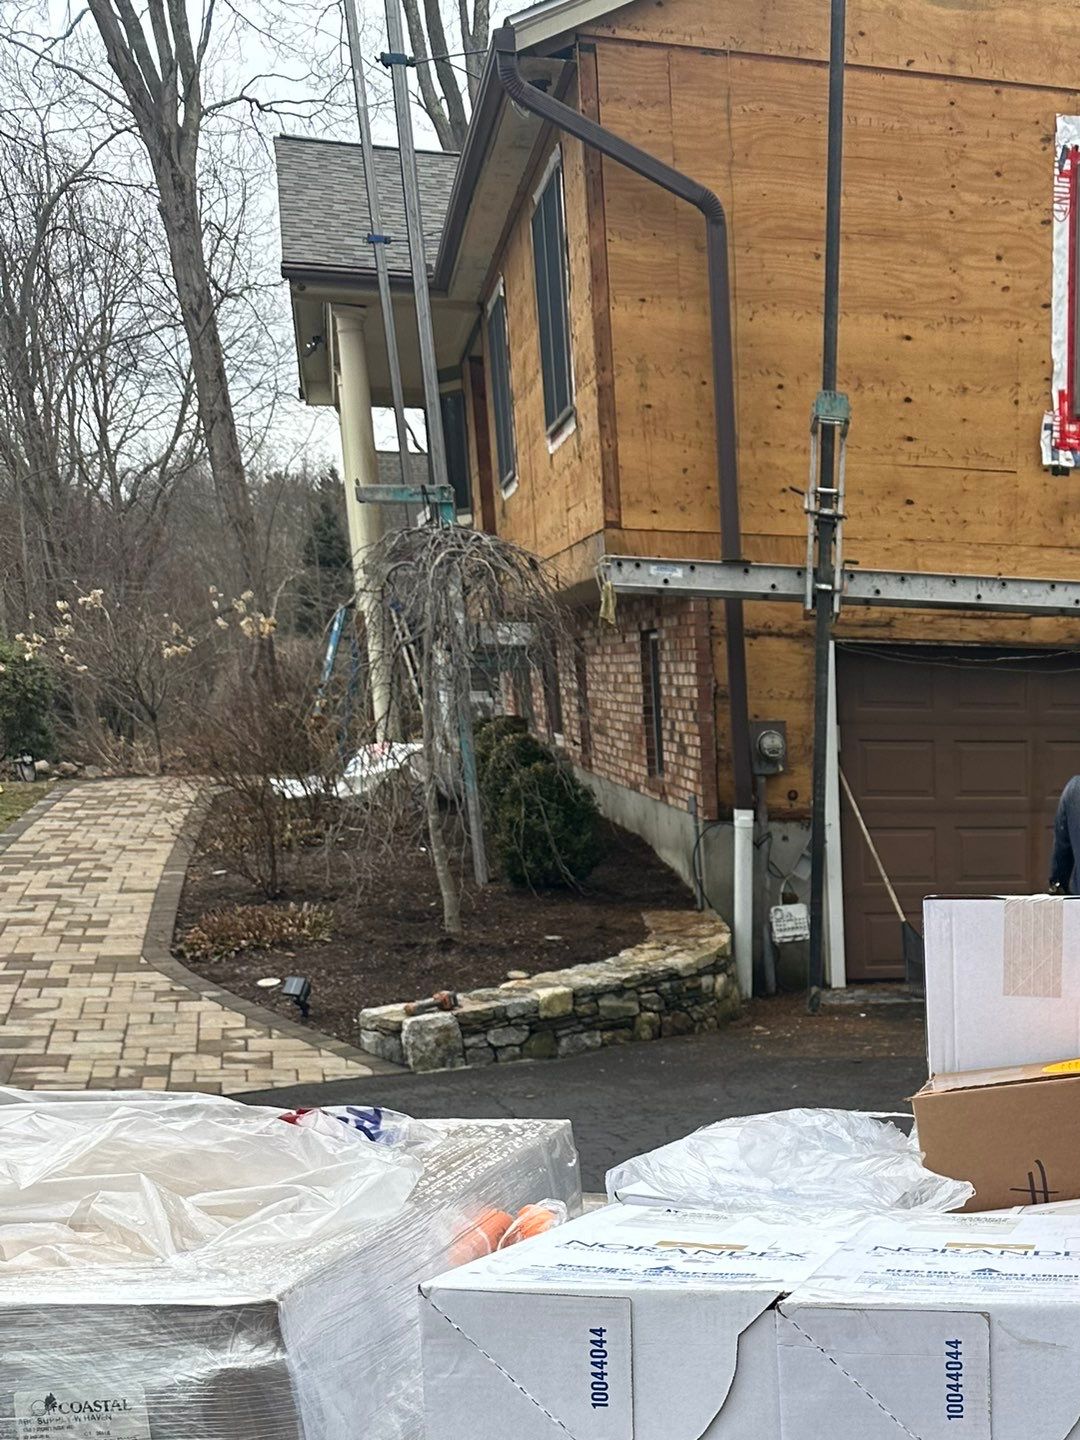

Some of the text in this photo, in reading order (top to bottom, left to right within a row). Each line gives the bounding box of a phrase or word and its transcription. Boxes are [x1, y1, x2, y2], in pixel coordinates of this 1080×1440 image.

[566, 1239, 806, 1258] NORANDEX
[589, 1326, 609, 1410] 10044044
[945, 1338, 964, 1421] 10044044
[58, 1399, 132, 1414] COASTAL
